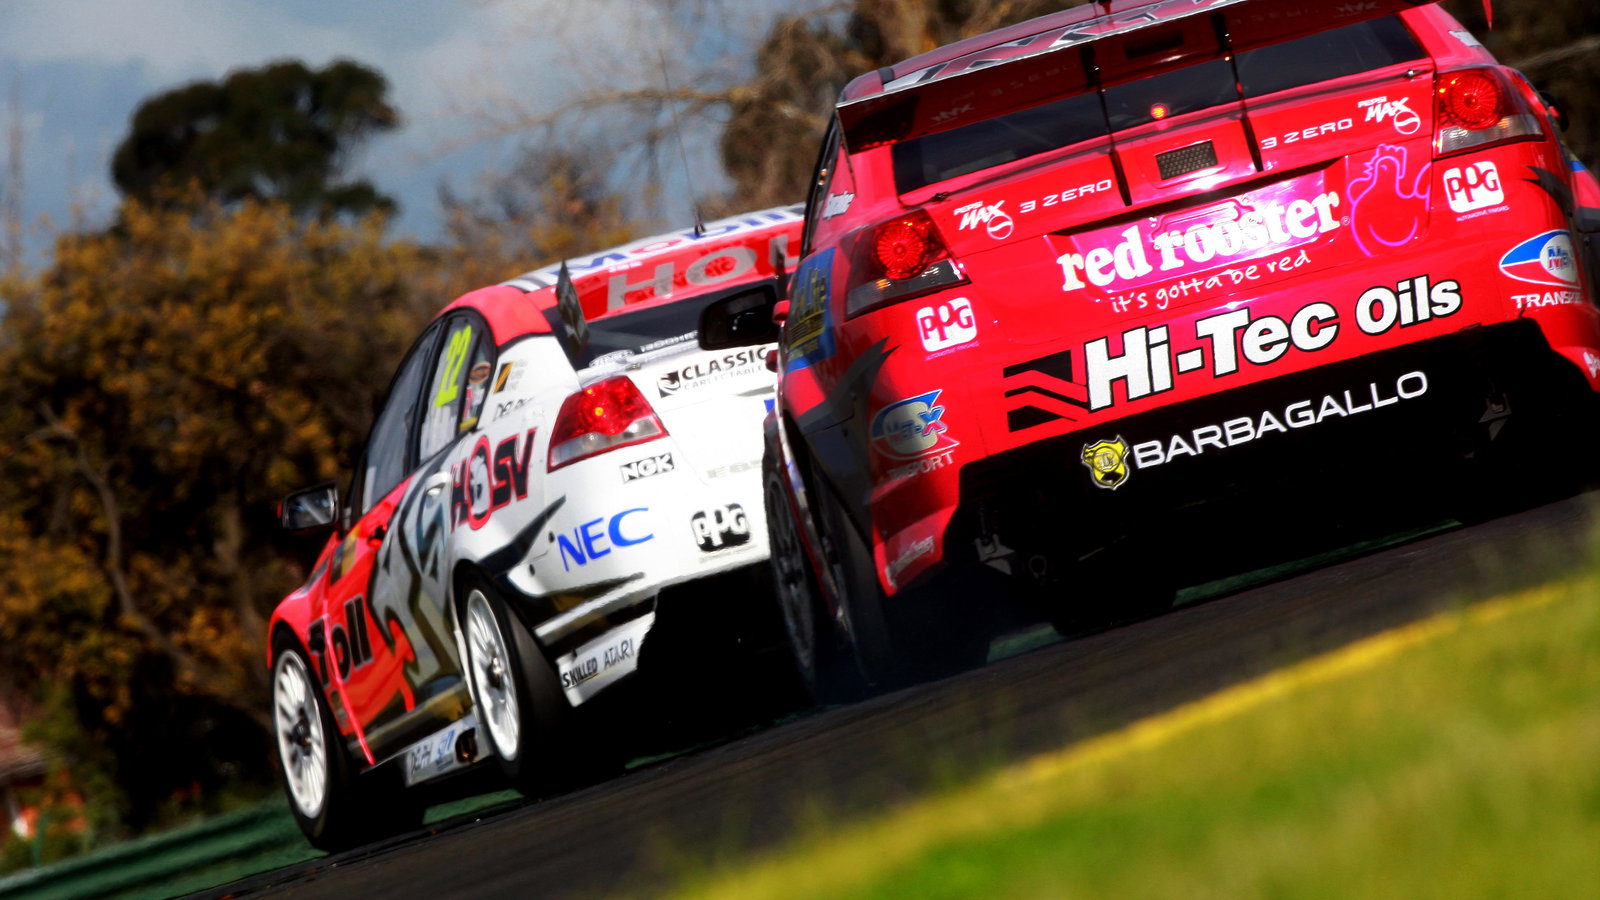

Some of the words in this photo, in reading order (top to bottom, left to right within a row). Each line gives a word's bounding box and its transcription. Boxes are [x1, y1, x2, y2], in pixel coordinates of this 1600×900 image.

[1363, 97, 1411, 124] MAX
[1260, 136, 1278, 150] 3
[1283, 118, 1353, 145] ZERO
[1019, 199, 1037, 214] 3
[1042, 179, 1112, 207] ZERO
[1444, 162, 1503, 205] PPG
[957, 200, 1006, 231] MAX
[1056, 224, 1153, 291] red
[1152, 191, 1340, 271] rooster
[1110, 291, 1149, 313] it's
[1156, 275, 1222, 309] gotta
[1228, 263, 1261, 285] be
[1268, 249, 1312, 274] red
[917, 298, 977, 345] PPG
[1084, 301, 1341, 414] Hi-Tec
[1355, 274, 1463, 337] Oils
[434, 324, 472, 408] 22
[681, 347, 767, 381] CLASSIC
[1132, 370, 1429, 470] BARBAGALLO
[621, 452, 675, 484] NGK
[557, 507, 655, 573] NEC
[692, 503, 750, 549] PPG
[562, 656, 598, 688] SKILLED
[603, 638, 635, 671] ATARI
